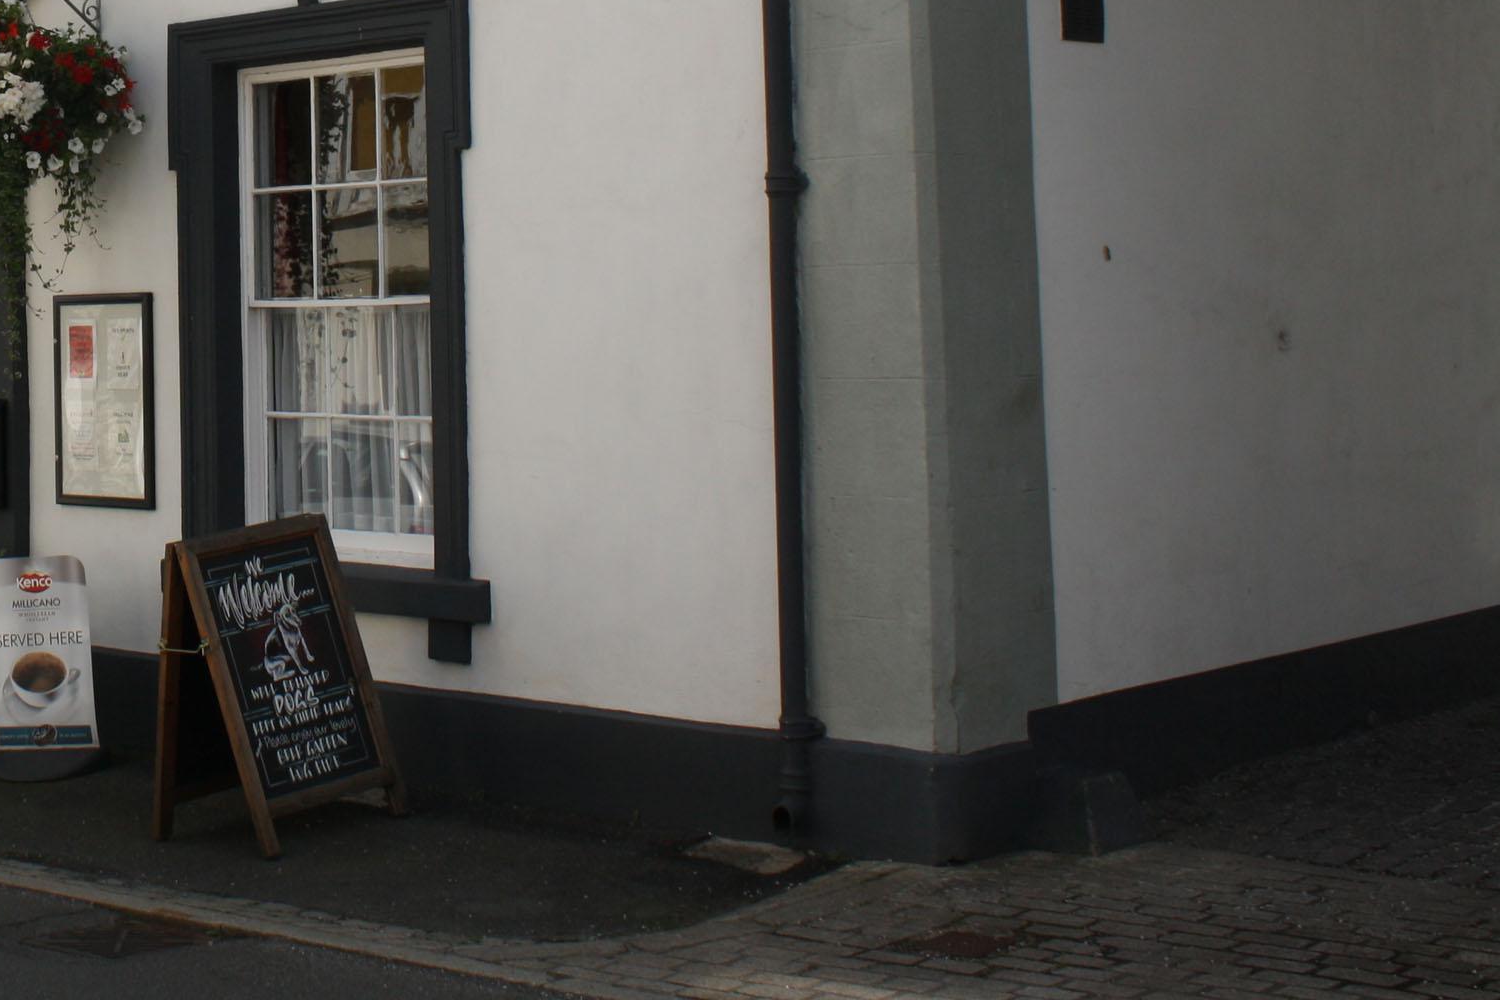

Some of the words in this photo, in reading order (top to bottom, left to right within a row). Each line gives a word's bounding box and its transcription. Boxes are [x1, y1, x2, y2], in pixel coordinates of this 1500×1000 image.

[16, 576, 53, 590] Kenco
[12, 597, 61, 609] MILLICANO
[49, 630, 84, 646] HERE
[282, 670, 330, 692] BEHAVED
[273, 684, 320, 717] DOGS
[306, 733, 349, 756] GARDEN
